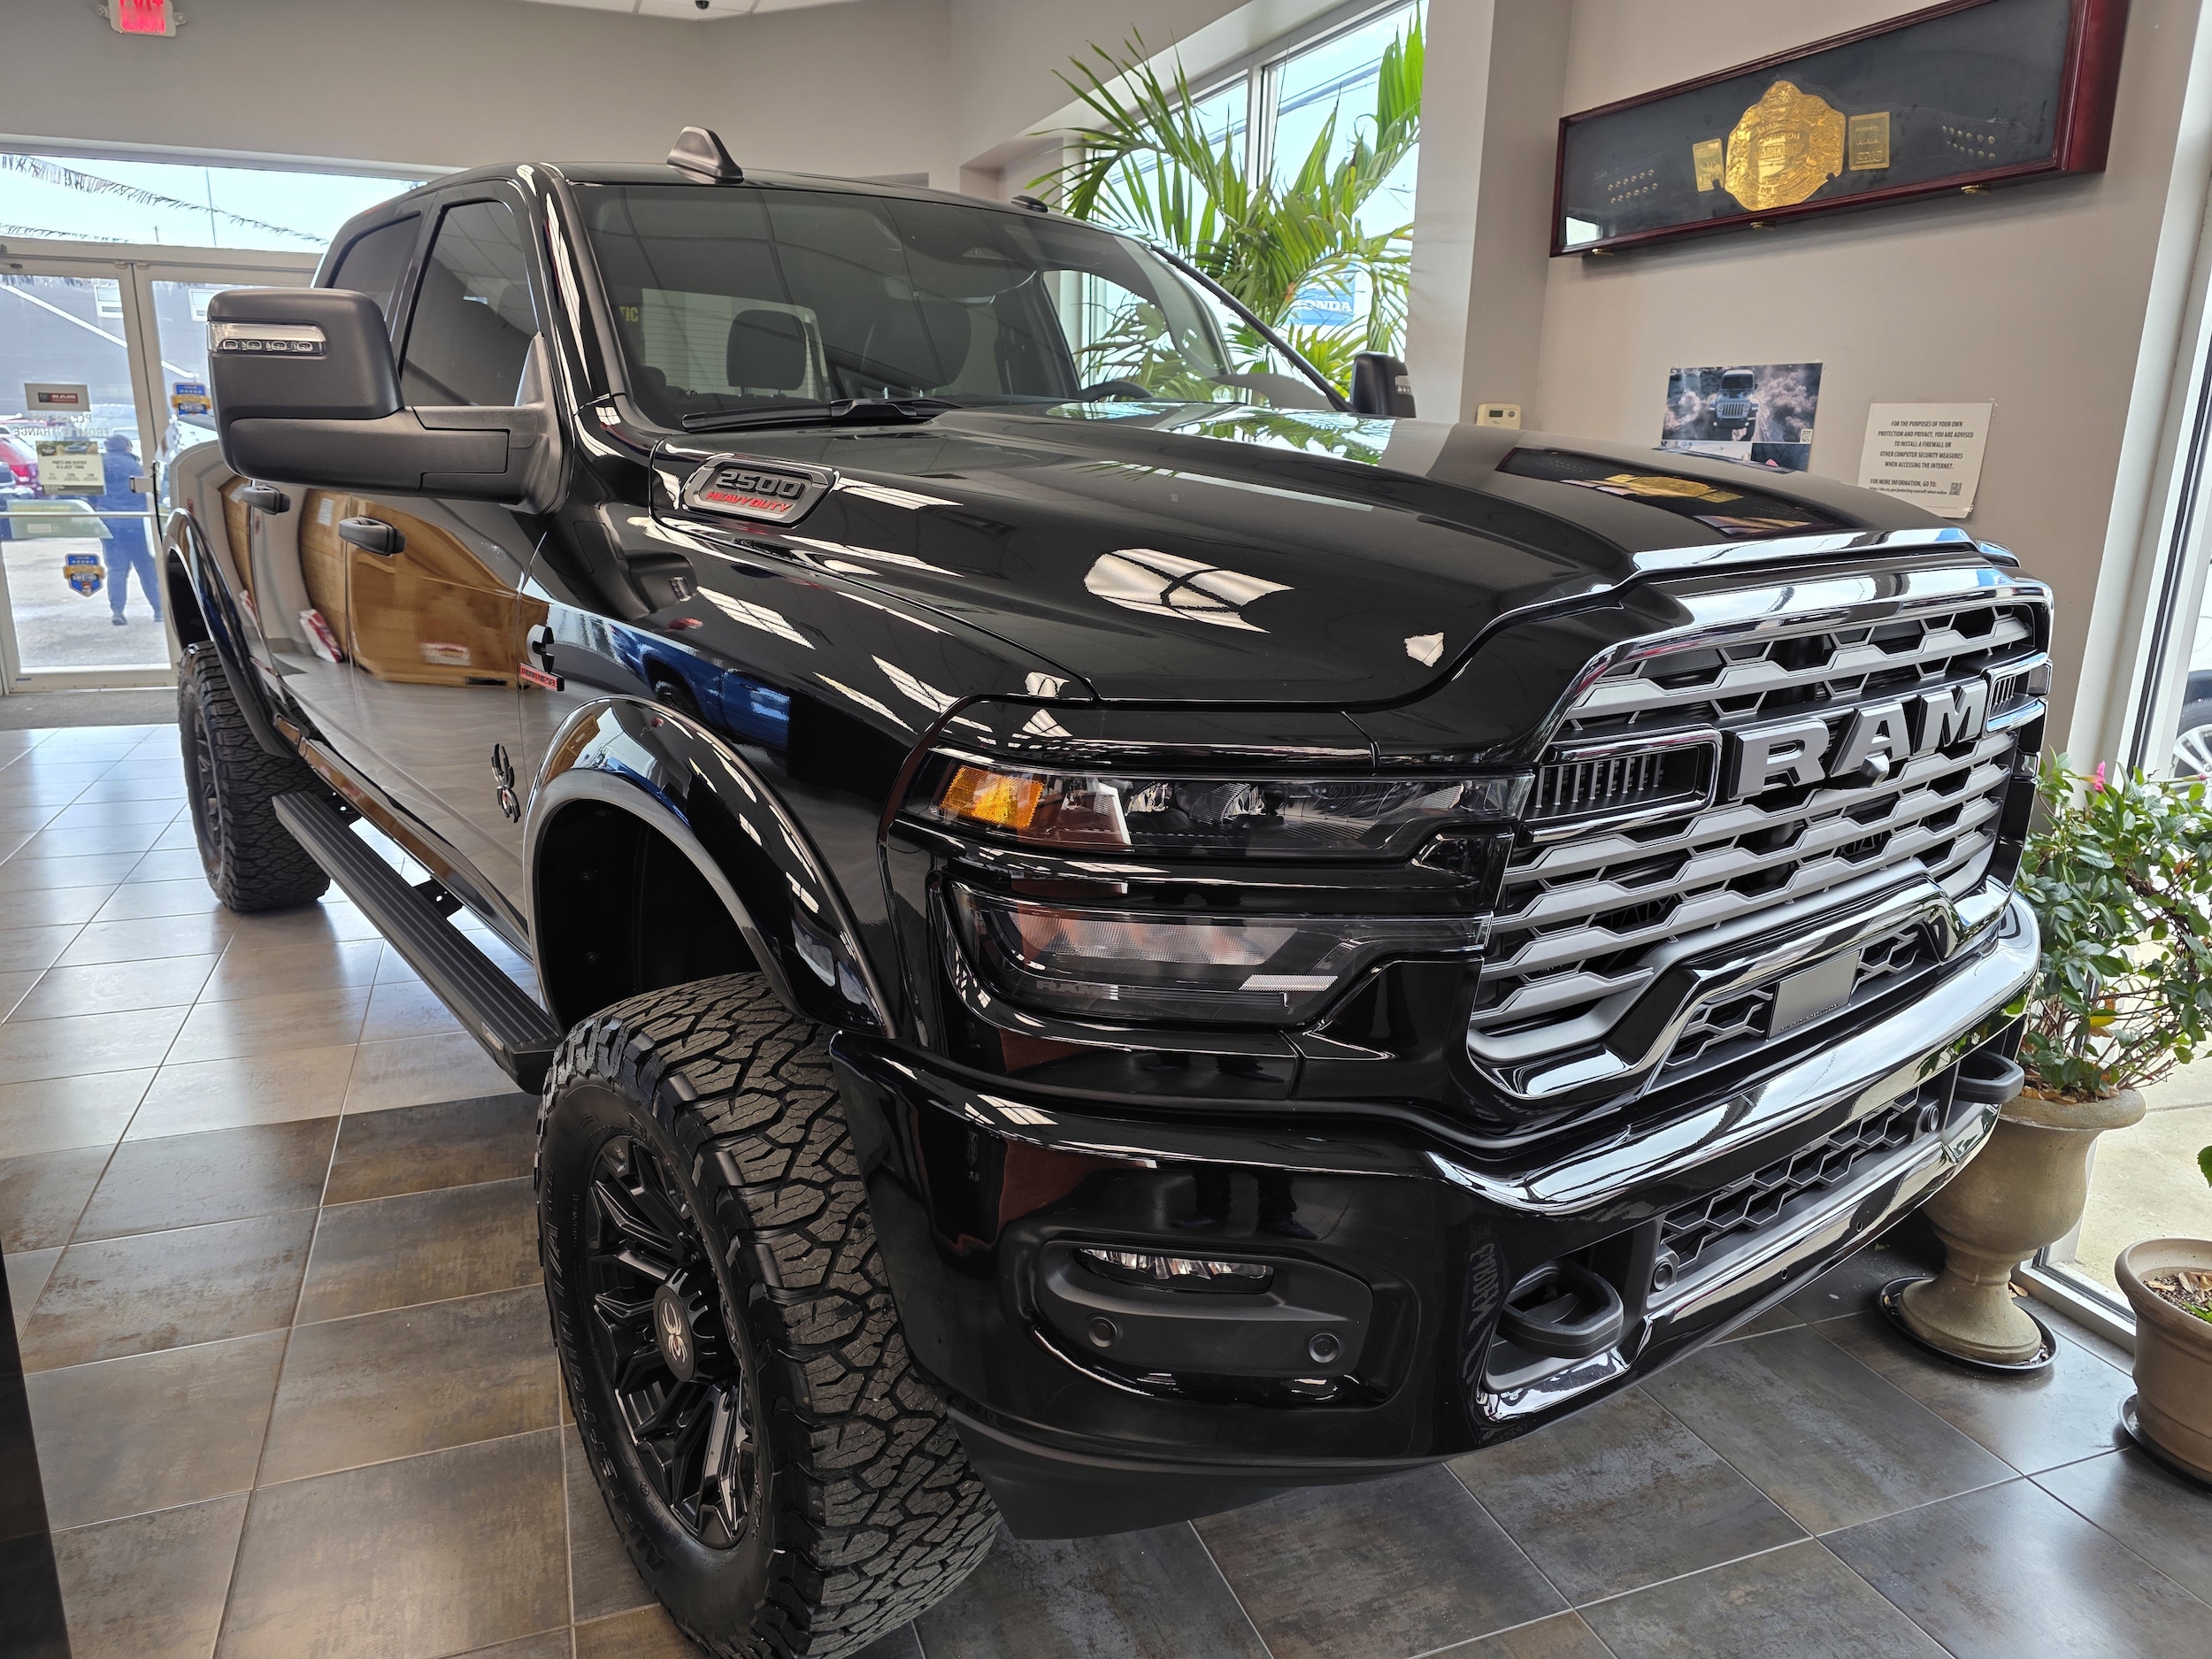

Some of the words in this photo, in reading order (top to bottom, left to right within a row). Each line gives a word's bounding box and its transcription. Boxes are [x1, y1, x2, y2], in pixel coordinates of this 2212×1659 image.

[715, 470, 805, 500] 2500
[706, 491, 754, 505] HEAVY
[749, 497, 793, 512] DUTY
[1729, 679, 1988, 800] RAM
[1036, 979, 1102, 996] RAM
